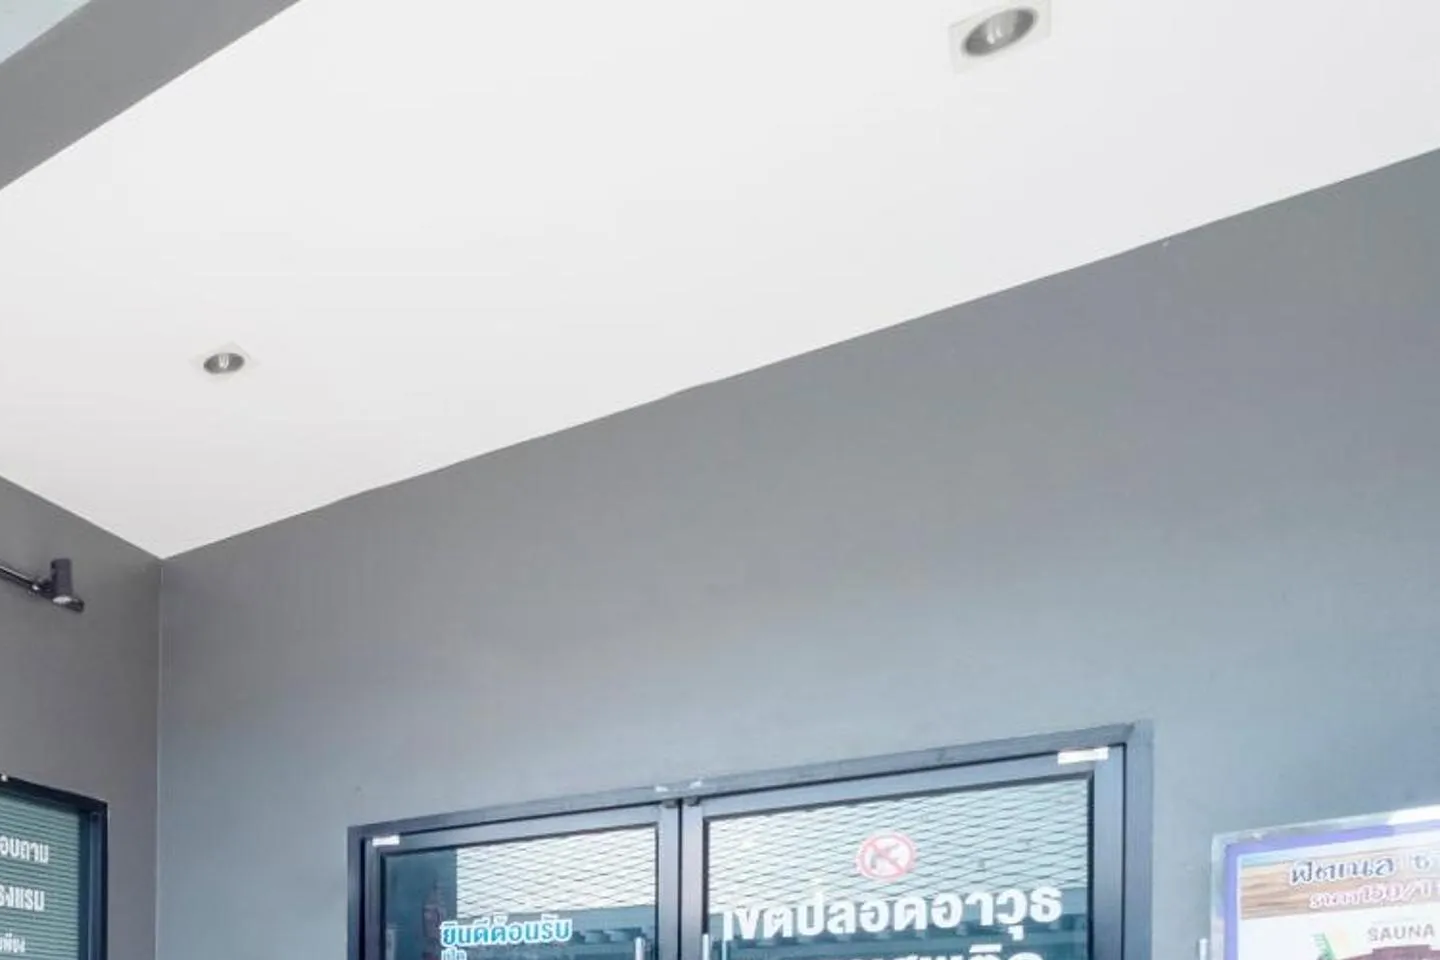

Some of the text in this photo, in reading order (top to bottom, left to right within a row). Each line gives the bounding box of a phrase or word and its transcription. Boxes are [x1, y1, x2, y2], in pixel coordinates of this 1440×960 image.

[439, 911, 573, 947] ยินดีต้อนรับ
[723, 886, 1063, 941] เขตปลอดอาวุธ
[1367, 923, 1436, 942] SAUNA
